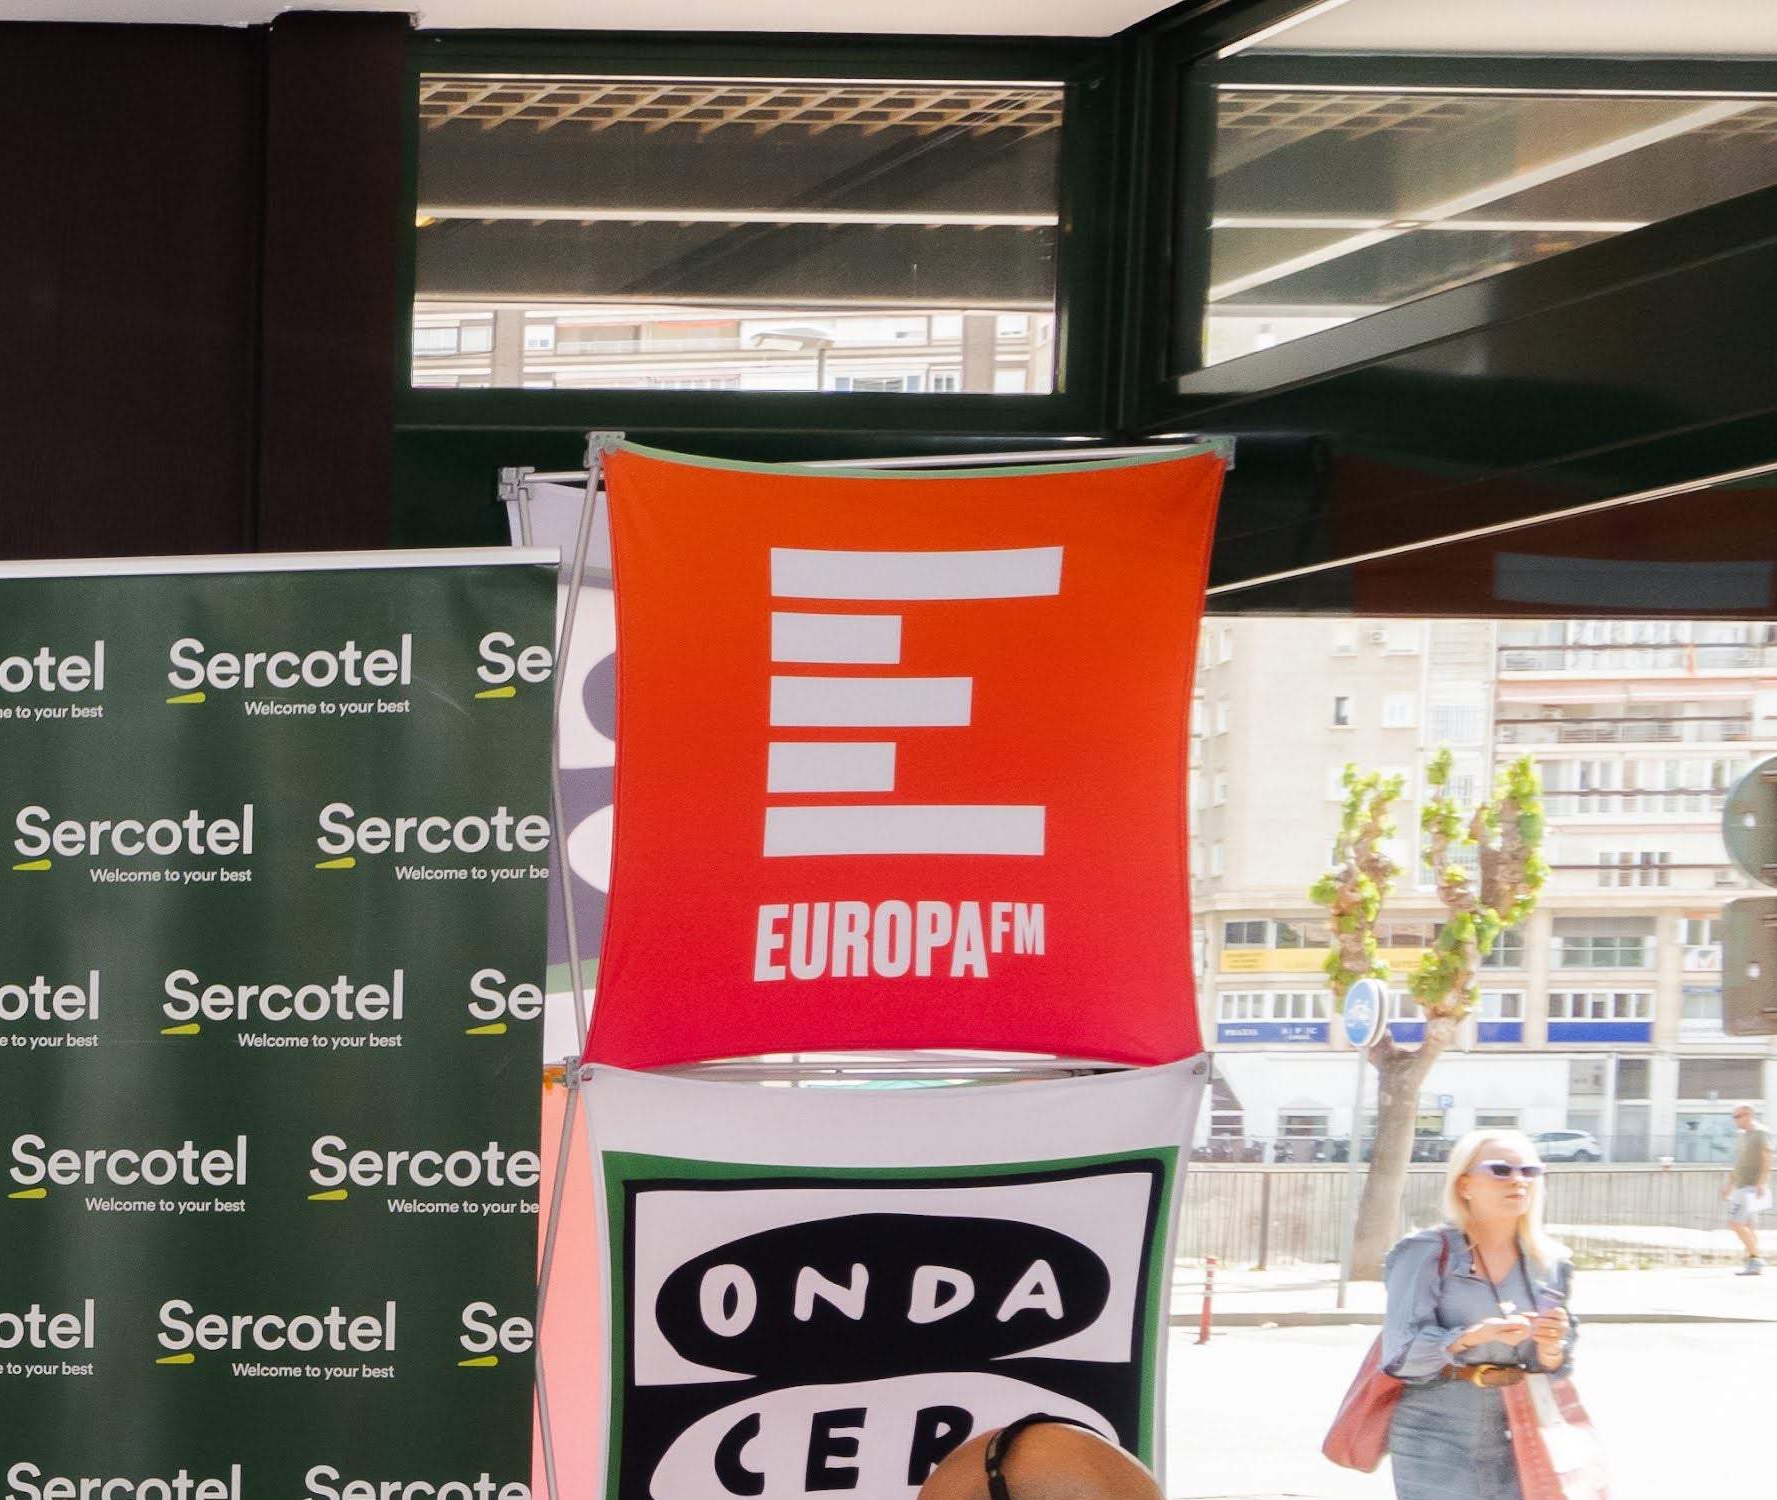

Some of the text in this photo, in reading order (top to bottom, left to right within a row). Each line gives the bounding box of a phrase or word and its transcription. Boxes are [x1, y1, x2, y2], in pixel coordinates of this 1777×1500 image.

[168, 634, 412, 689] Sercotel
[15, 706, 31, 718] to
[34, 708, 68, 721] your
[72, 704, 103, 718] best
[245, 699, 410, 716] Welcome to your best
[14, 804, 253, 856] Sercotel
[317, 803, 550, 854] Sercote
[90, 868, 251, 884] Welcome to your best
[395, 866, 468, 880] Welcome
[471, 867, 487, 879] to
[491, 869, 526, 882] your
[163, 969, 403, 1020] Sercotel
[11, 1034, 26, 1046] to
[30, 1037, 63, 1049] your
[67, 1033, 98, 1047] best
[238, 1033, 402, 1050] Welcome to your best
[10, 1134, 246, 1185] Sercotel
[310, 1136, 539, 1186] Sercote
[85, 1198, 245, 1214] Welcome to your best
[388, 1199, 459, 1213] Welcome
[462, 1201, 478, 1213] to
[482, 1203, 517, 1216] your
[700, 1259, 1063, 1337] ONDA
[158, 1300, 395, 1351] Sercotel
[7, 1363, 21, 1374] to
[25, 1365, 59, 1377] your
[62, 1362, 93, 1375] best
[232, 1363, 394, 1380] Welcome to your best
[713, 1406, 975, 1497] CER
